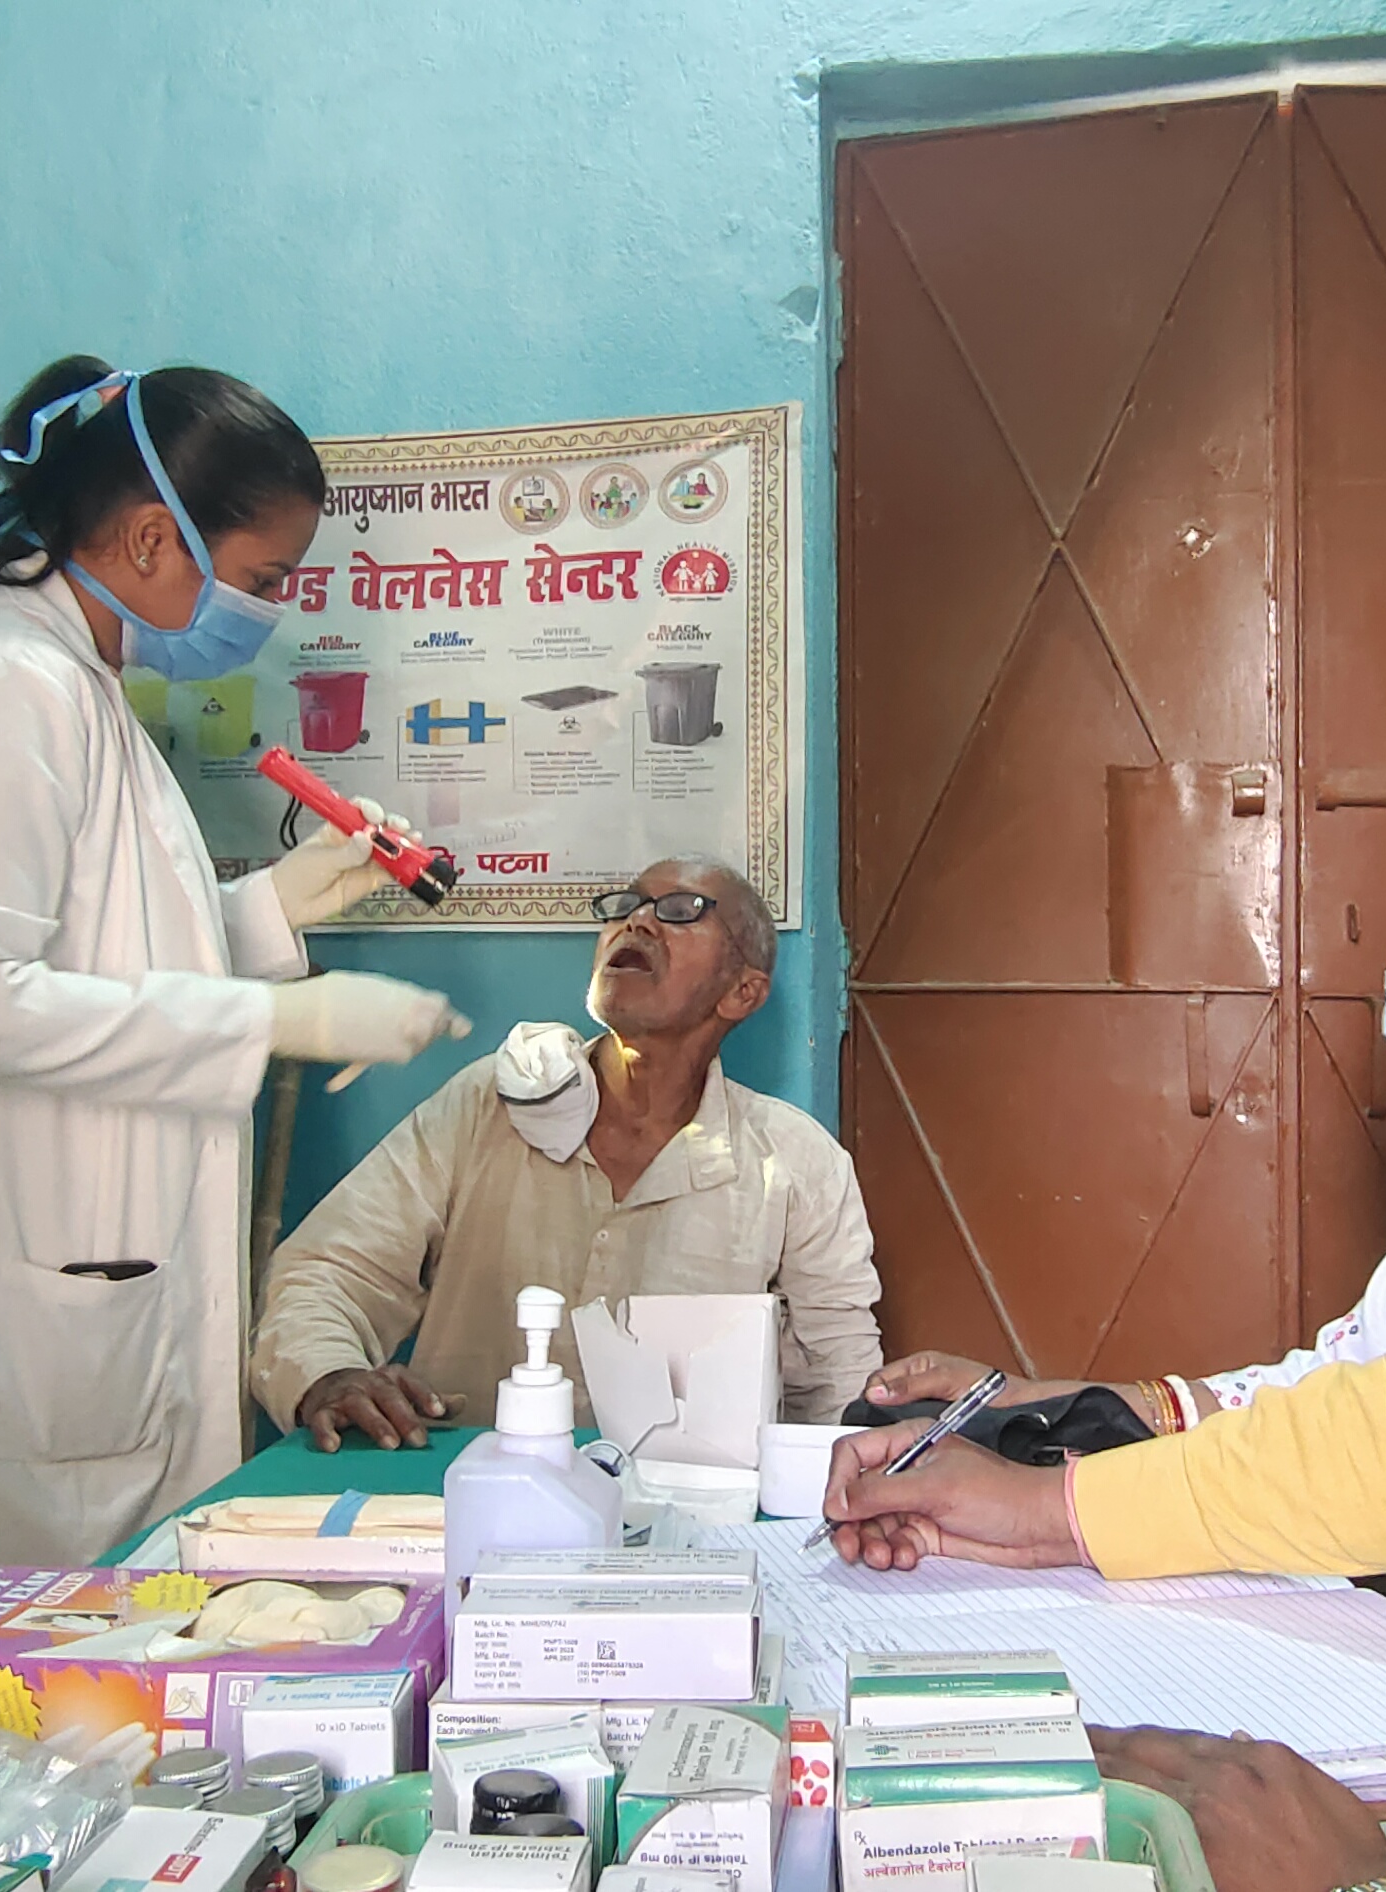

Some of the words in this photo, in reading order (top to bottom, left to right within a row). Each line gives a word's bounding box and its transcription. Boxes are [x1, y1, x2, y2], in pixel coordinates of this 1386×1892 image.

[322, 481, 424, 534] आयुष्मान
[429, 480, 491, 512] भारत
[676, 541, 719, 554] HEALTH
[349, 549, 510, 612] वेलनेस
[524, 543, 644, 604] सेन्टर
[542, 627, 582, 637] WHITE
[659, 624, 701, 634] BLACK
[318, 635, 344, 645] RED
[429, 631, 460, 641] BLUE
[647, 631, 712, 641] CATEGORY
[299, 642, 362, 652] CATEGORY
[413, 637, 474, 649] CATEGORY
[477, 851, 551, 874] पटना
[2, 1570, 61, 1601] EXAM
[37, 1572, 90, 1605] GLOVES
[493, 1651, 511, 1659] Date
[474, 1670, 497, 1679] Expiry
[499, 1670, 517, 1678] Date
[436, 1713, 501, 1724] Composition:
[315, 1723, 327, 1733] 10
[350, 1721, 387, 1732] Tablets
[436, 1725, 455, 1735] Each
[606, 1732, 631, 1741] Batch
[689, 1754, 712, 1783] Tablets
[491, 1843, 508, 1852] IP
[512, 1844, 572, 1854] Tablets
[863, 1840, 951, 1859] Albendazole
[470, 1850, 570, 1862] Telmisartan
[640, 1853, 660, 1863] mg
[663, 1853, 684, 1863] 100
[688, 1854, 700, 1864] IP
[703, 1854, 748, 1865] Tablets
